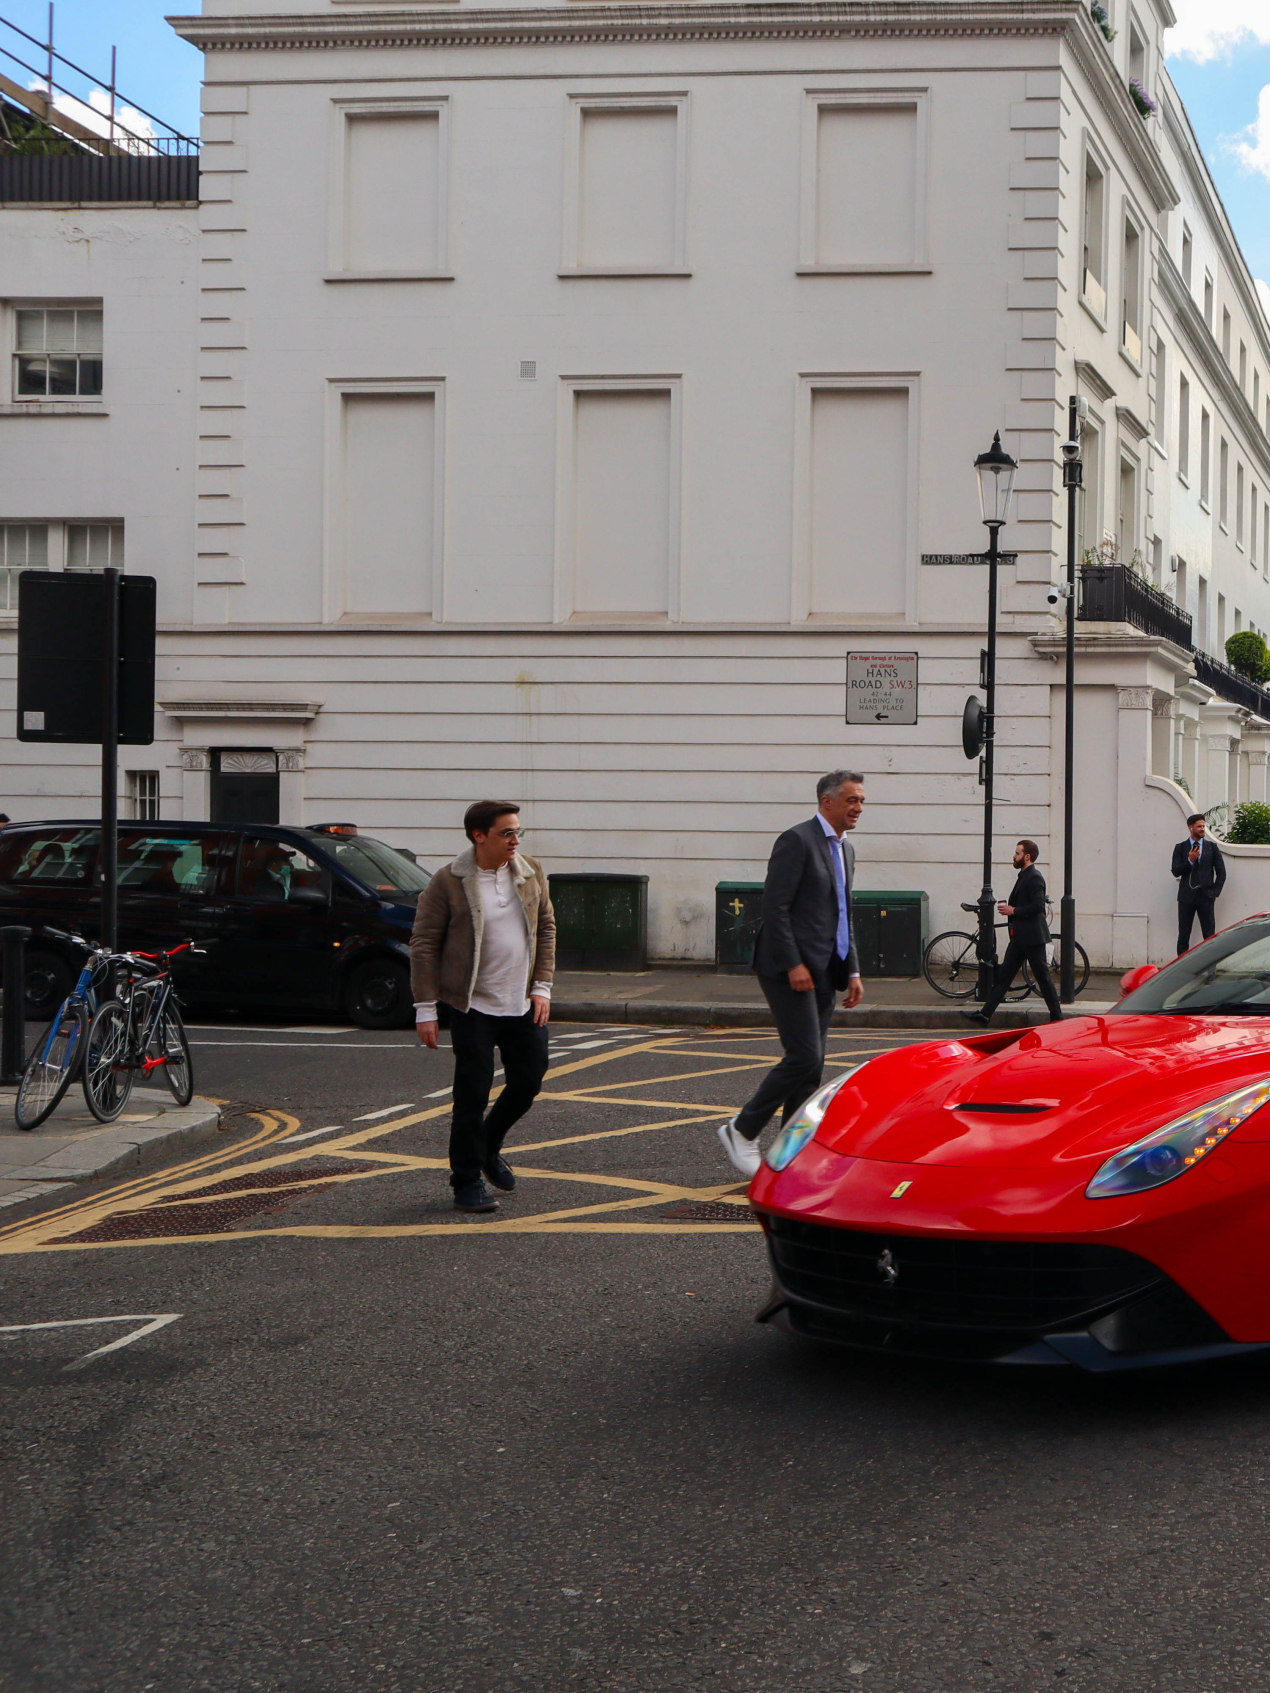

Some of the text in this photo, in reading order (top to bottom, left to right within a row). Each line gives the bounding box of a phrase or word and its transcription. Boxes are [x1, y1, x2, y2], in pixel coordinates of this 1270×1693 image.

[923, 555, 950, 564] HANS
[954, 555, 980, 564] ROAD
[866, 668, 898, 678] HANS
